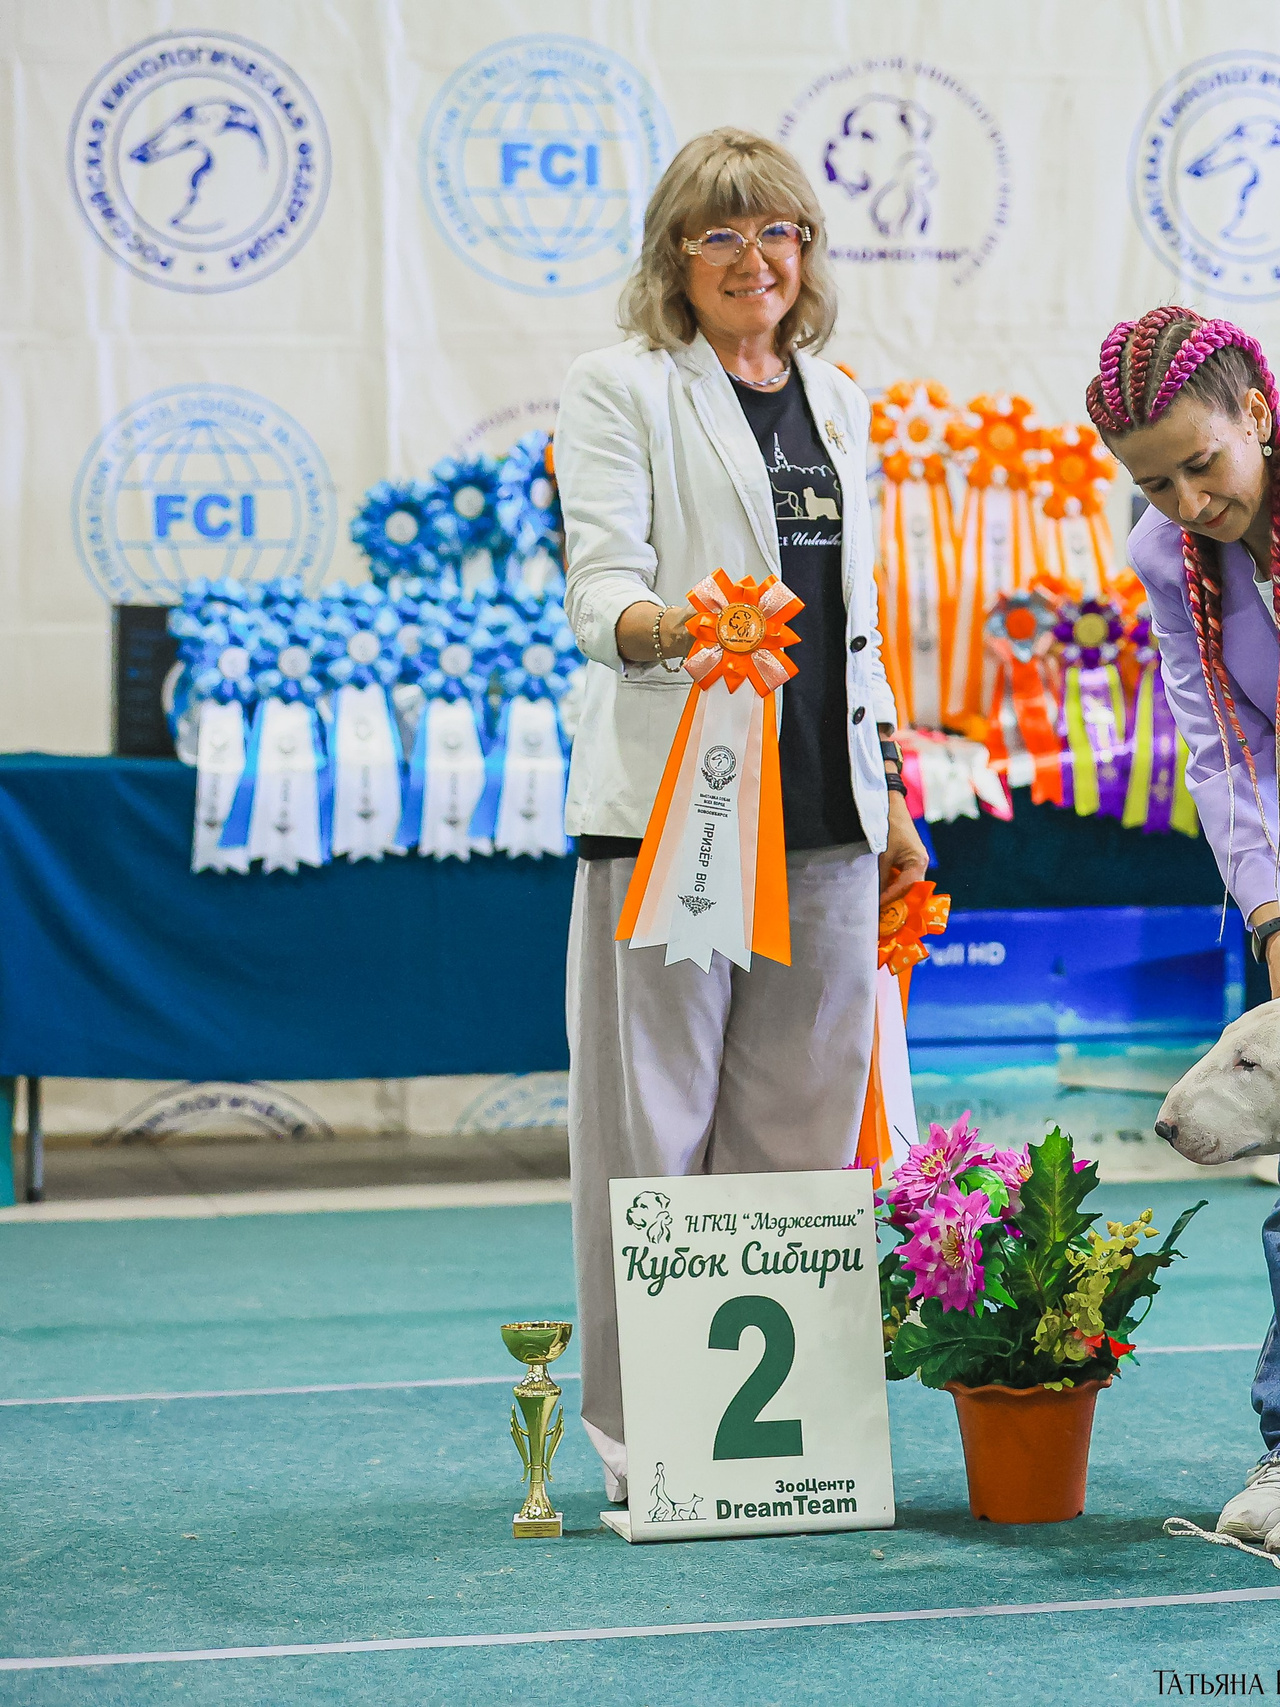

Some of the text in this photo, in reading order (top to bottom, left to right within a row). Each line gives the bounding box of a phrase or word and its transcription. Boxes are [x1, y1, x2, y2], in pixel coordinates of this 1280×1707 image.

[502, 142, 599, 188] FCI
[153, 493, 256, 540] FCI
[694, 822, 715, 893] ПРИЗЁР BIG
[685, 1213, 738, 1235] НГКЦ
[622, 1240, 864, 1297] Кубок Сибири
[708, 1294, 804, 1462] 2
[716, 1495, 858, 1520] DreamTeam
[775, 1478, 856, 1494] ЗооЦентр
